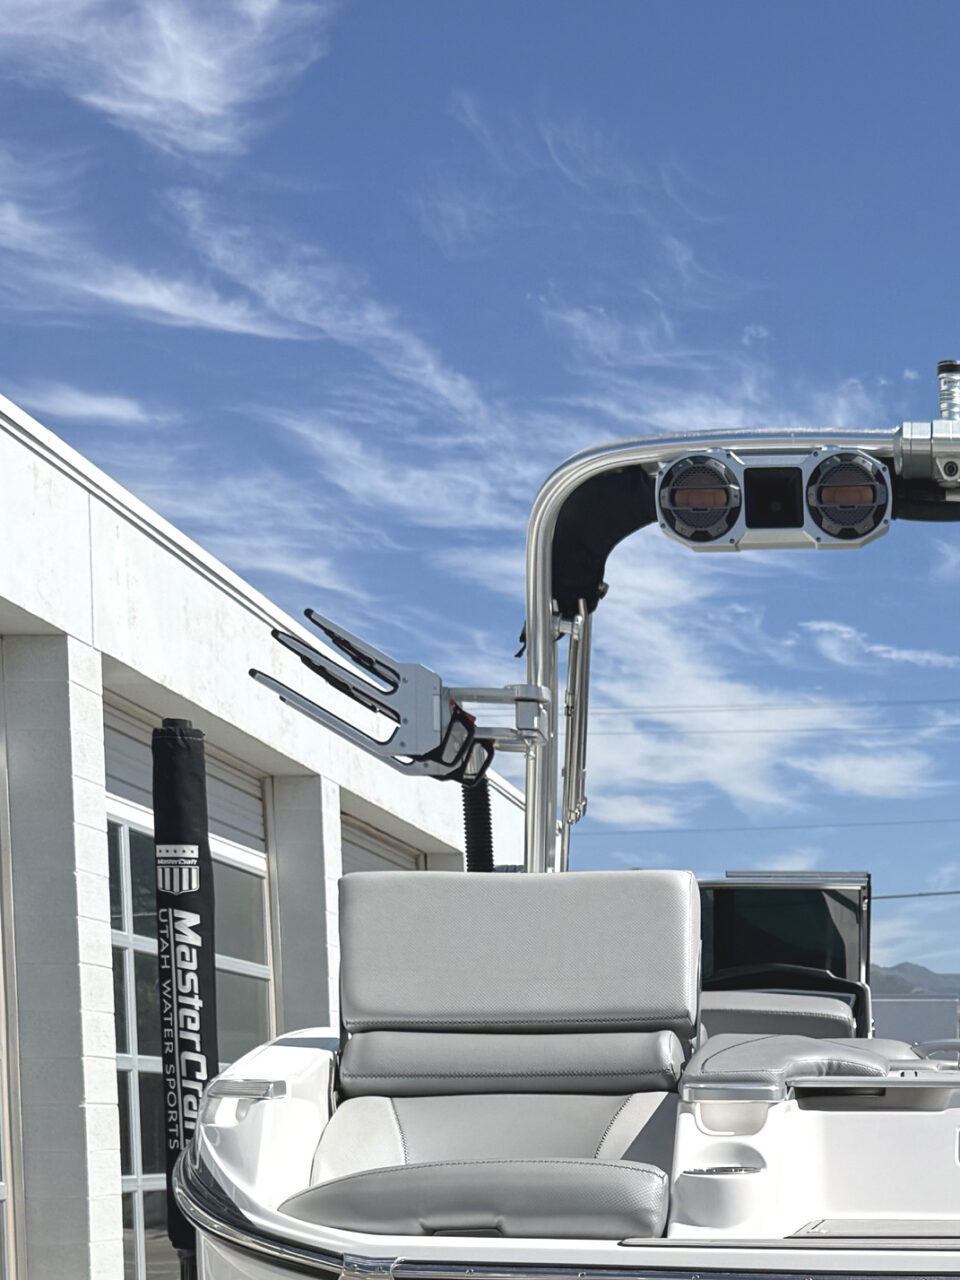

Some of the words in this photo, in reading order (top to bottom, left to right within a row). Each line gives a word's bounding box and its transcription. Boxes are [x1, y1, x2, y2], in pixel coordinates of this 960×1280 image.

[158, 908, 171, 969] UTAH
[161, 979, 174, 1054] WATER
[173, 908, 208, 1143] MasterCra
[164, 1063, 180, 1150] SPORTS
